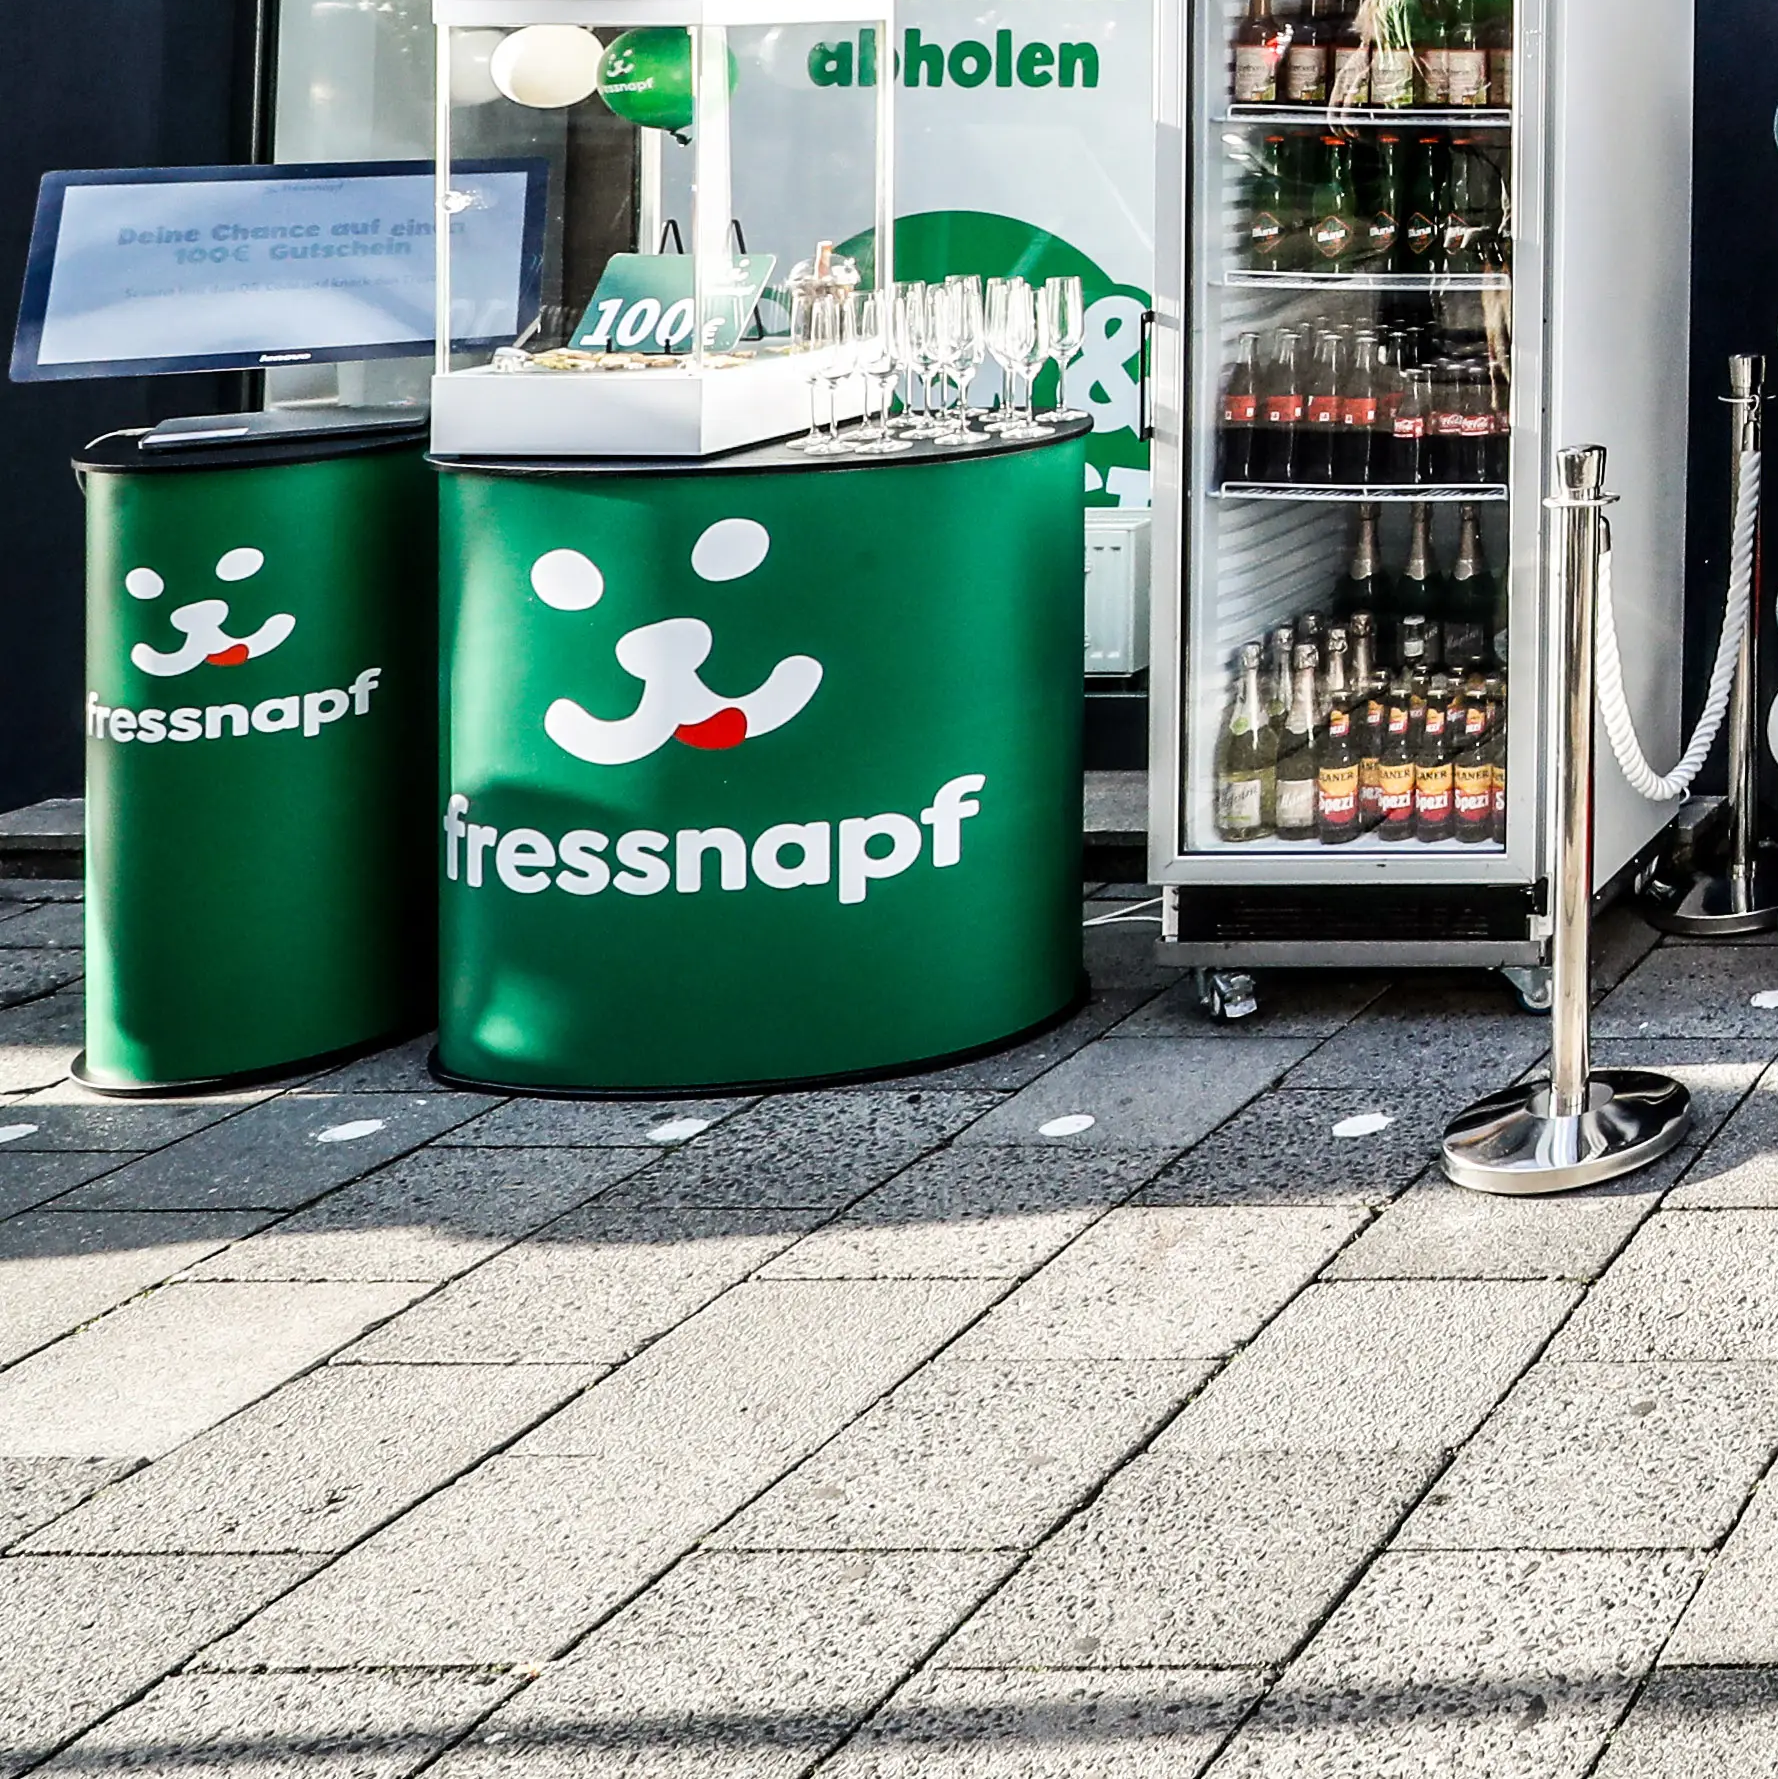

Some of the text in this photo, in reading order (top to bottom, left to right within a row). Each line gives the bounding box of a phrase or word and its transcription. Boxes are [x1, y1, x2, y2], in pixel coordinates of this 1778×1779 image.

[117, 216, 466, 246] Deine Chance auf einn
[269, 237, 412, 262] Gutschein
[86, 666, 381, 745] fressnapf
[1455, 789, 1489, 813] Spezi
[444, 773, 986, 906] fressnapf
